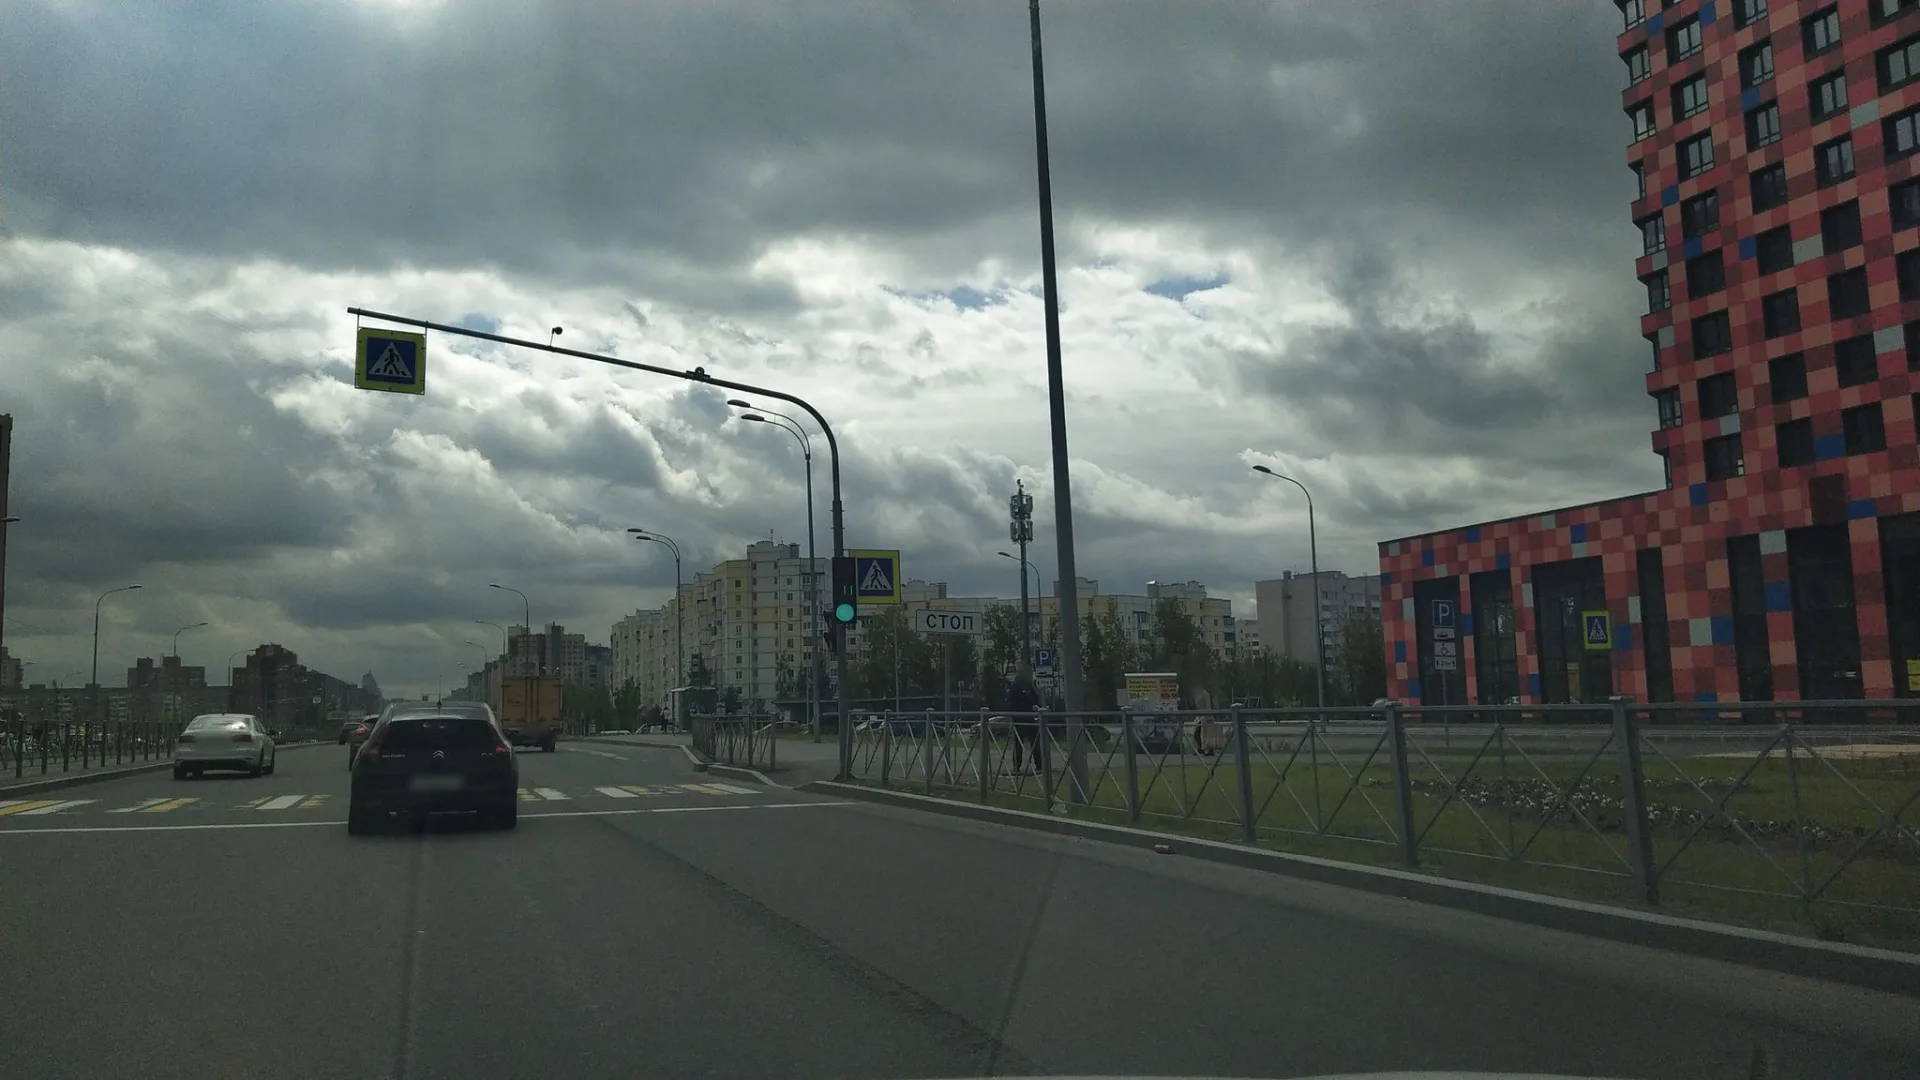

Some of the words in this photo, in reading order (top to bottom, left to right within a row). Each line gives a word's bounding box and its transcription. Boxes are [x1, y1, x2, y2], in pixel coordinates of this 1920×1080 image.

[926, 613, 973, 631] СТОП
[1439, 603, 1450, 624] P
[1039, 650, 1049, 665] P
